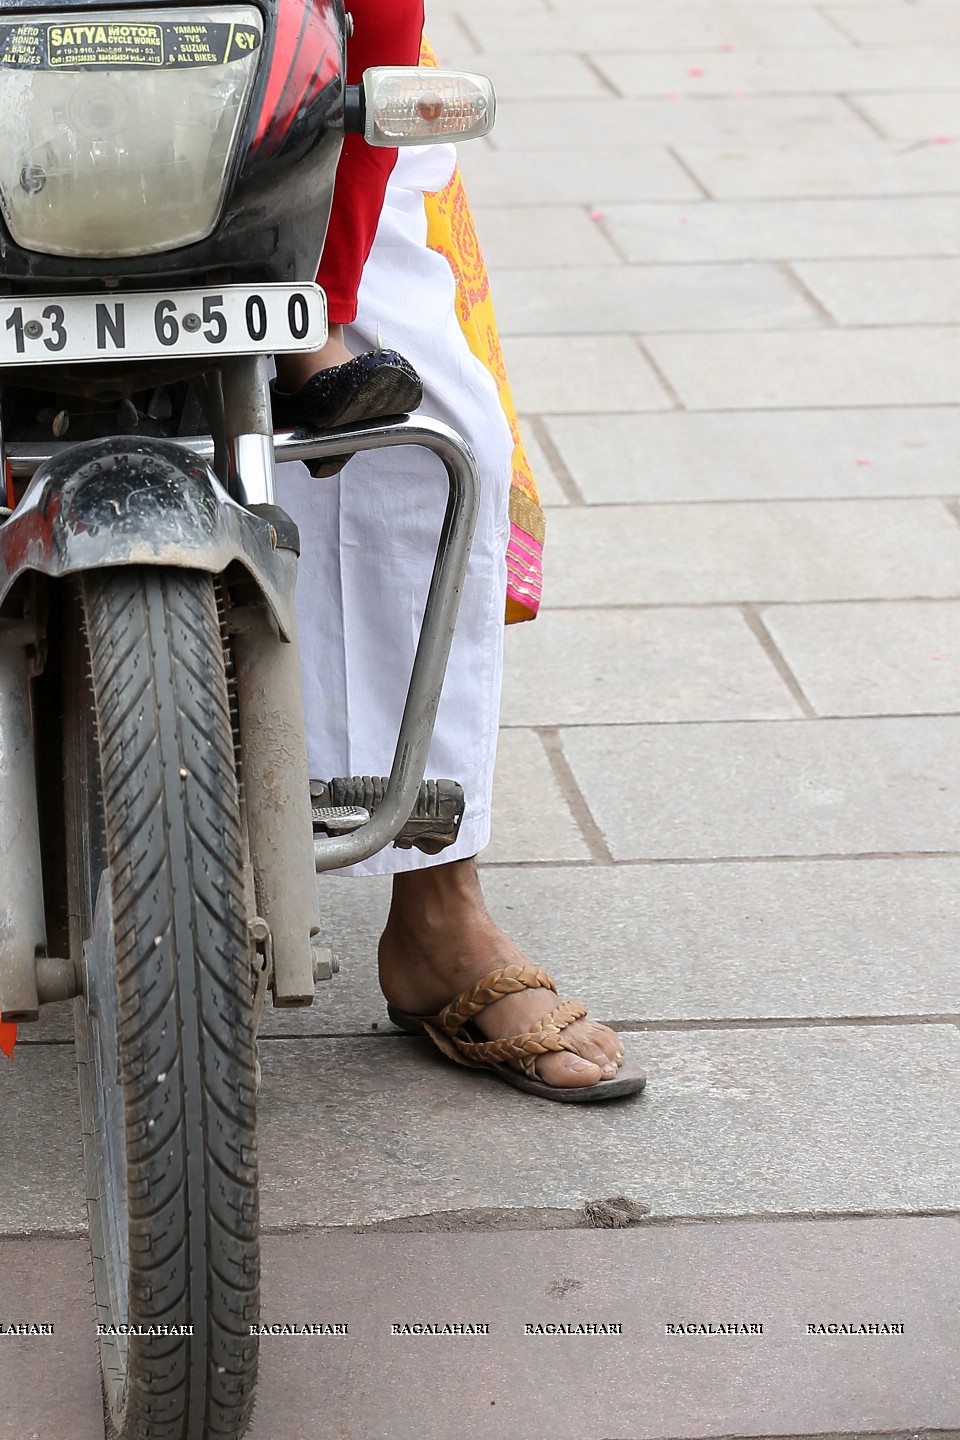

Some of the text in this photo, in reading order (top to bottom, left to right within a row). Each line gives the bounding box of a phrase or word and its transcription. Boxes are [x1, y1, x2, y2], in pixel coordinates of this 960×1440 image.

[173, 26, 207, 34] YAMAHA
[12, 36, 39, 45] HONDA
[51, 26, 157, 46] SATYA MOTOR
[108, 36, 160, 46] CYCLE WORKS
[180, 44, 210, 52] SUZUKI
[2, 55, 16, 63] ALL
[169, 54, 176, 62] &
[178, 54, 193, 62] ALL
[194, 53, 217, 62] BIKES
